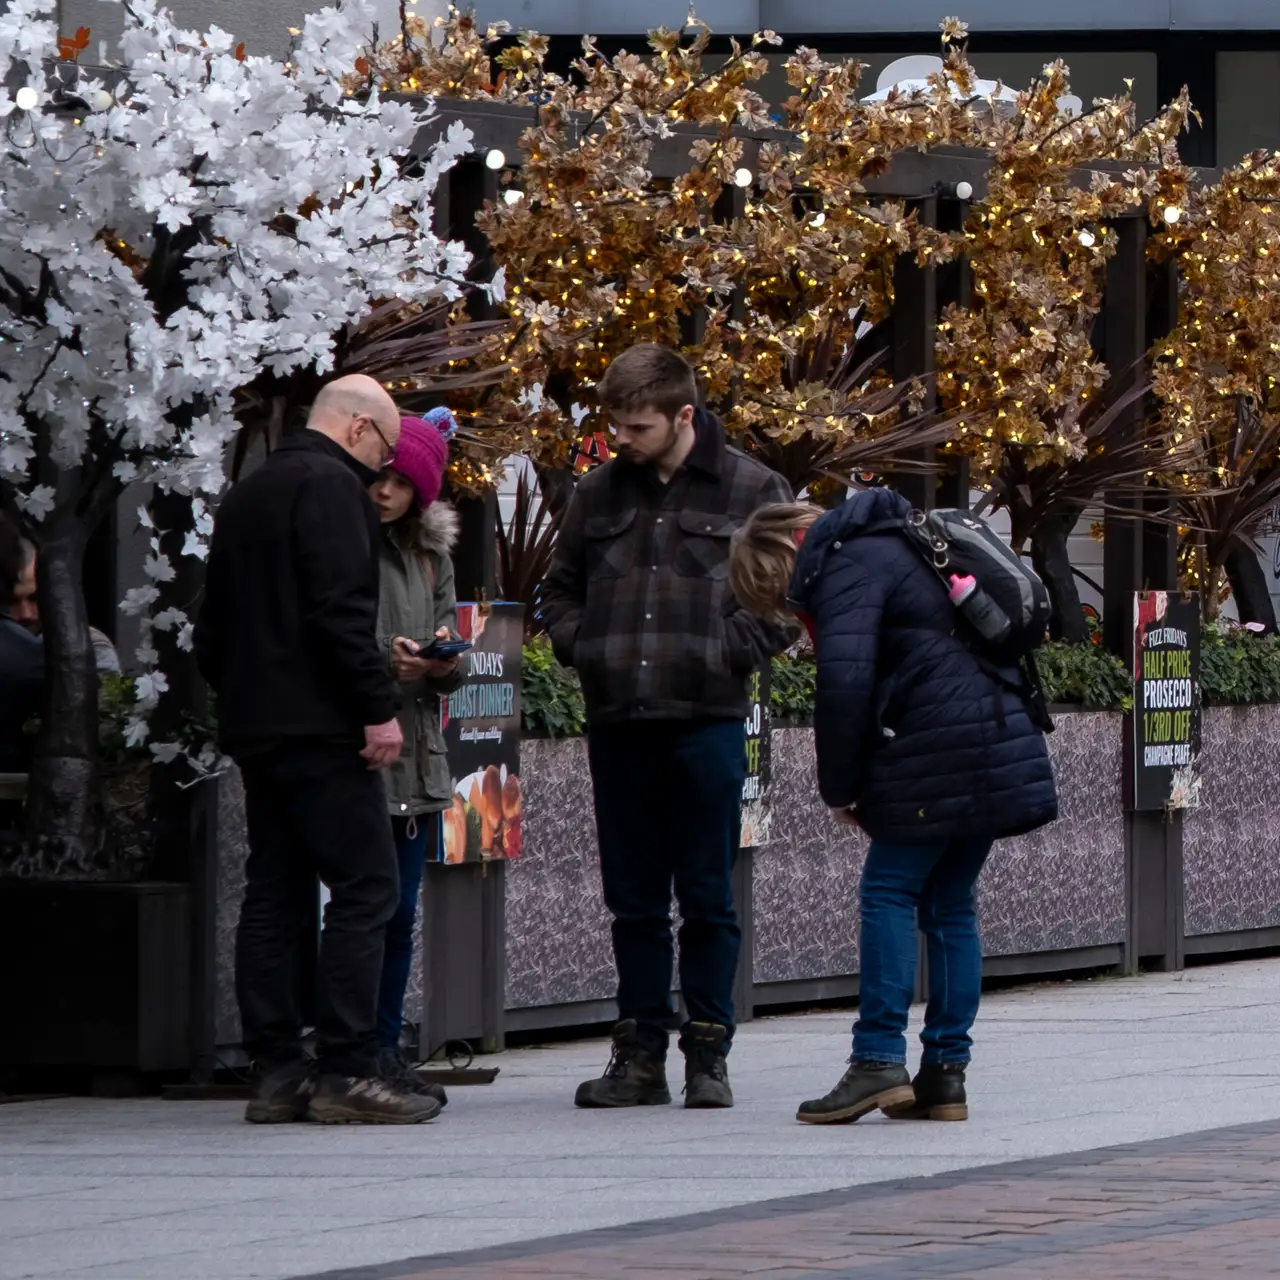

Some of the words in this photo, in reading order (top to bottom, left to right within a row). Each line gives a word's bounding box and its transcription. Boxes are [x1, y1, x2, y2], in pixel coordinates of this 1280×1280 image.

[1148, 628, 1164, 648] FIZZ
[1164, 627, 1187, 647] FRIDAYS
[1143, 651, 1165, 679] HALF
[1166, 650, 1192, 679] PRICE
[449, 683, 478, 718] ROAST
[479, 682, 514, 717] DINNER
[1143, 679, 1192, 709] PROSECCO
[1143, 711, 1172, 743] 1/3RD
[1174, 710, 1192, 742] OFF
[1144, 744, 1174, 767] CHAMPAGNE
